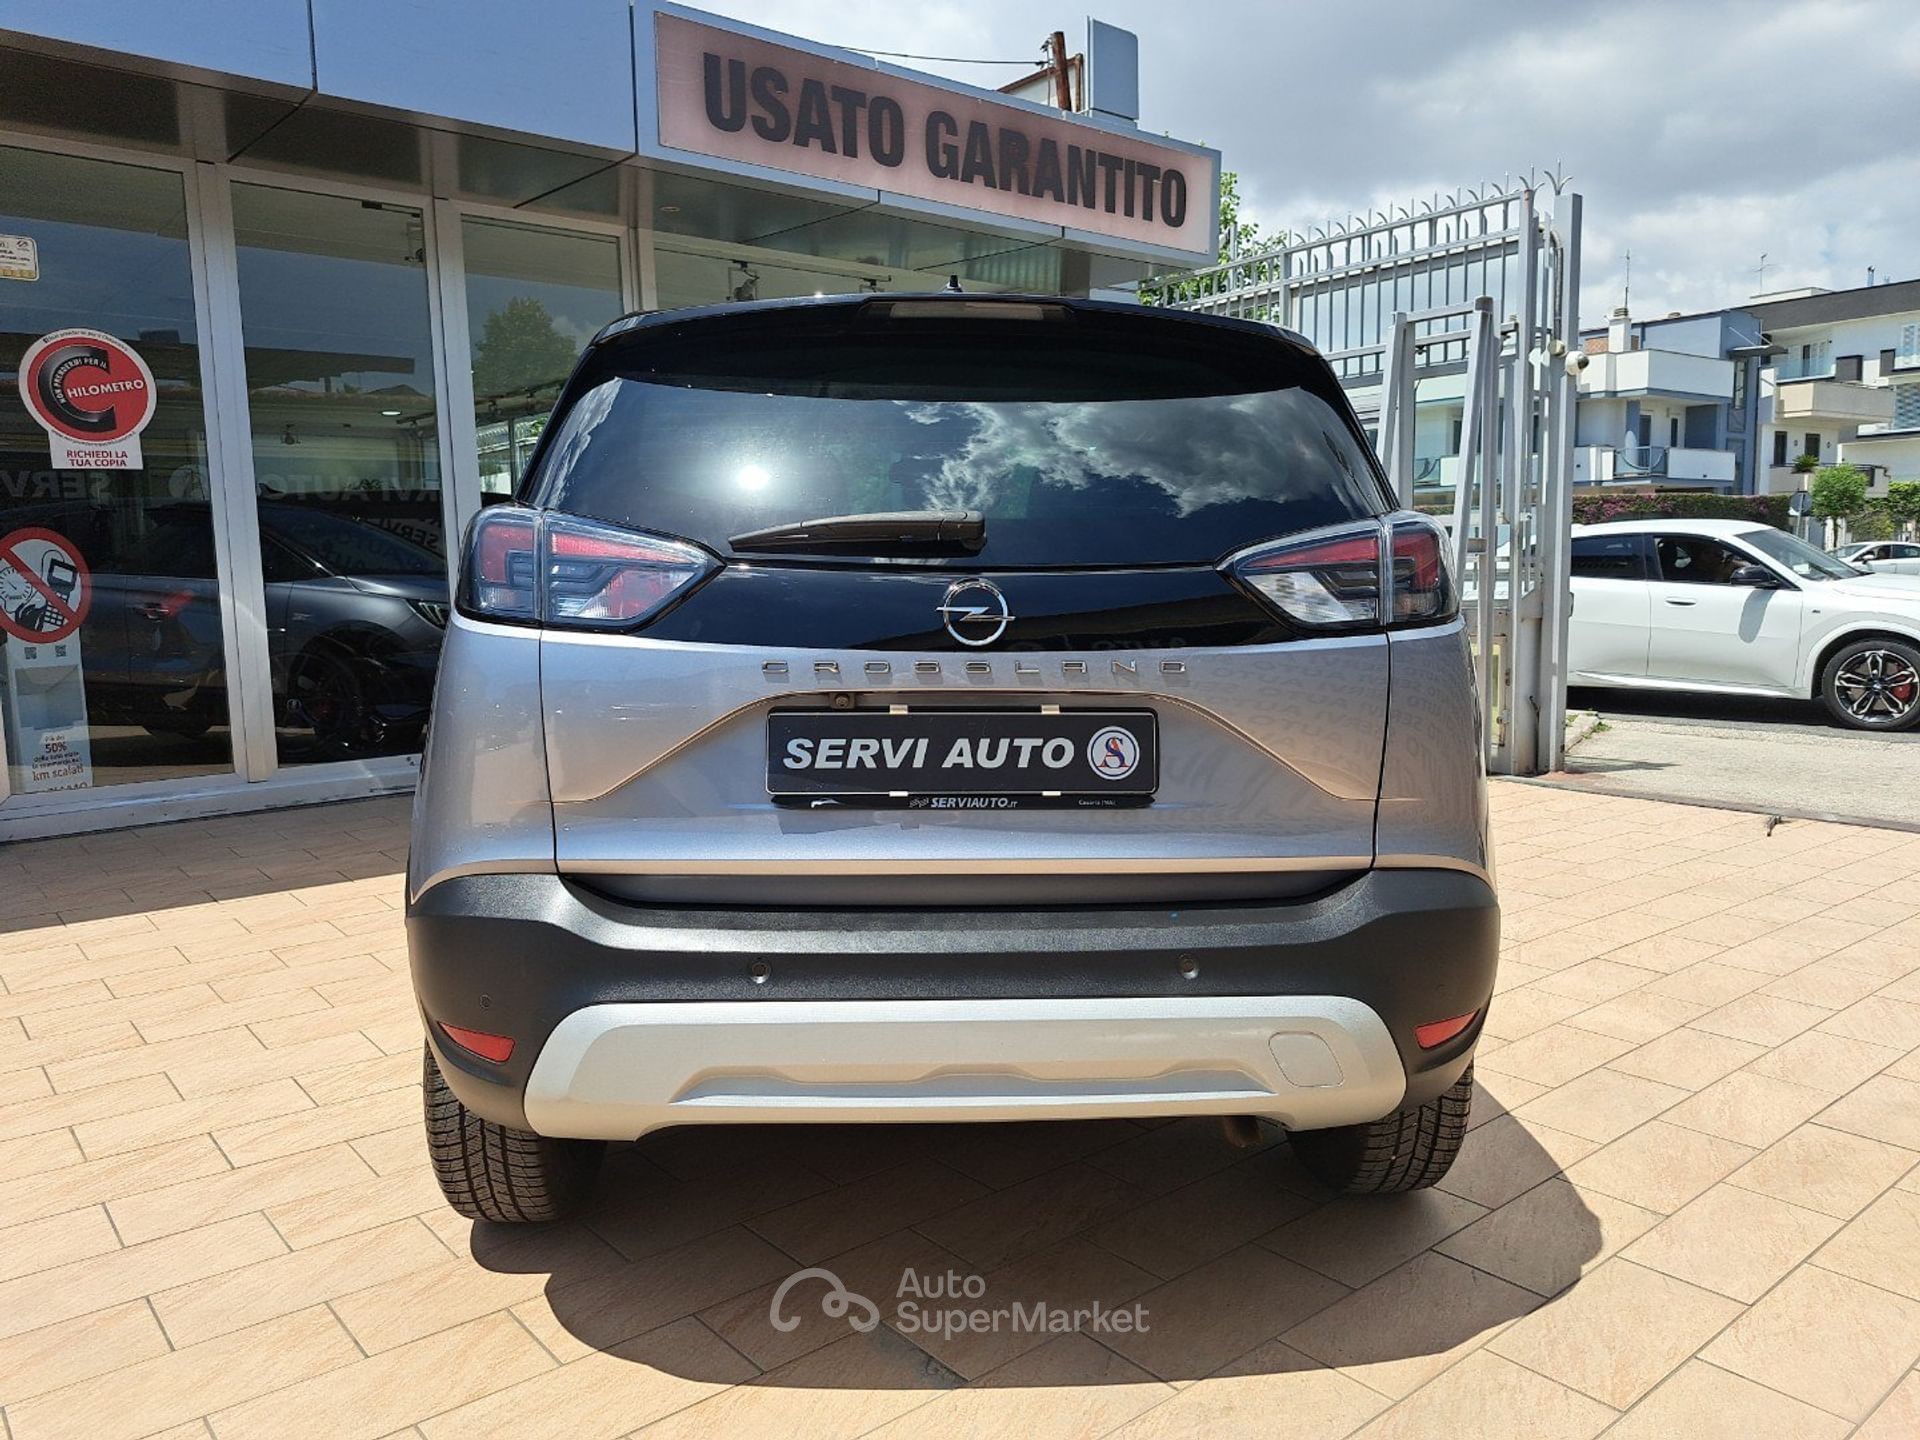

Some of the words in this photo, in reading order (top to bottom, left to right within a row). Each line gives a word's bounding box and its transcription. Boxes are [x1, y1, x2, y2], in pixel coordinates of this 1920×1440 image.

[703, 52, 904, 168] USATO
[925, 110, 1187, 228] GARANTITO
[66, 449, 114, 459] RICHIEDI
[115, 450, 128, 459] LA
[69, 459, 93, 467] TUA
[94, 459, 127, 467] COPIA
[761, 659, 1186, 674] CROSSLAND
[45, 741, 68, 754] 50%
[782, 737, 929, 770] SERVI
[942, 737, 1074, 770] AUTO
[32, 770, 50, 781] km
